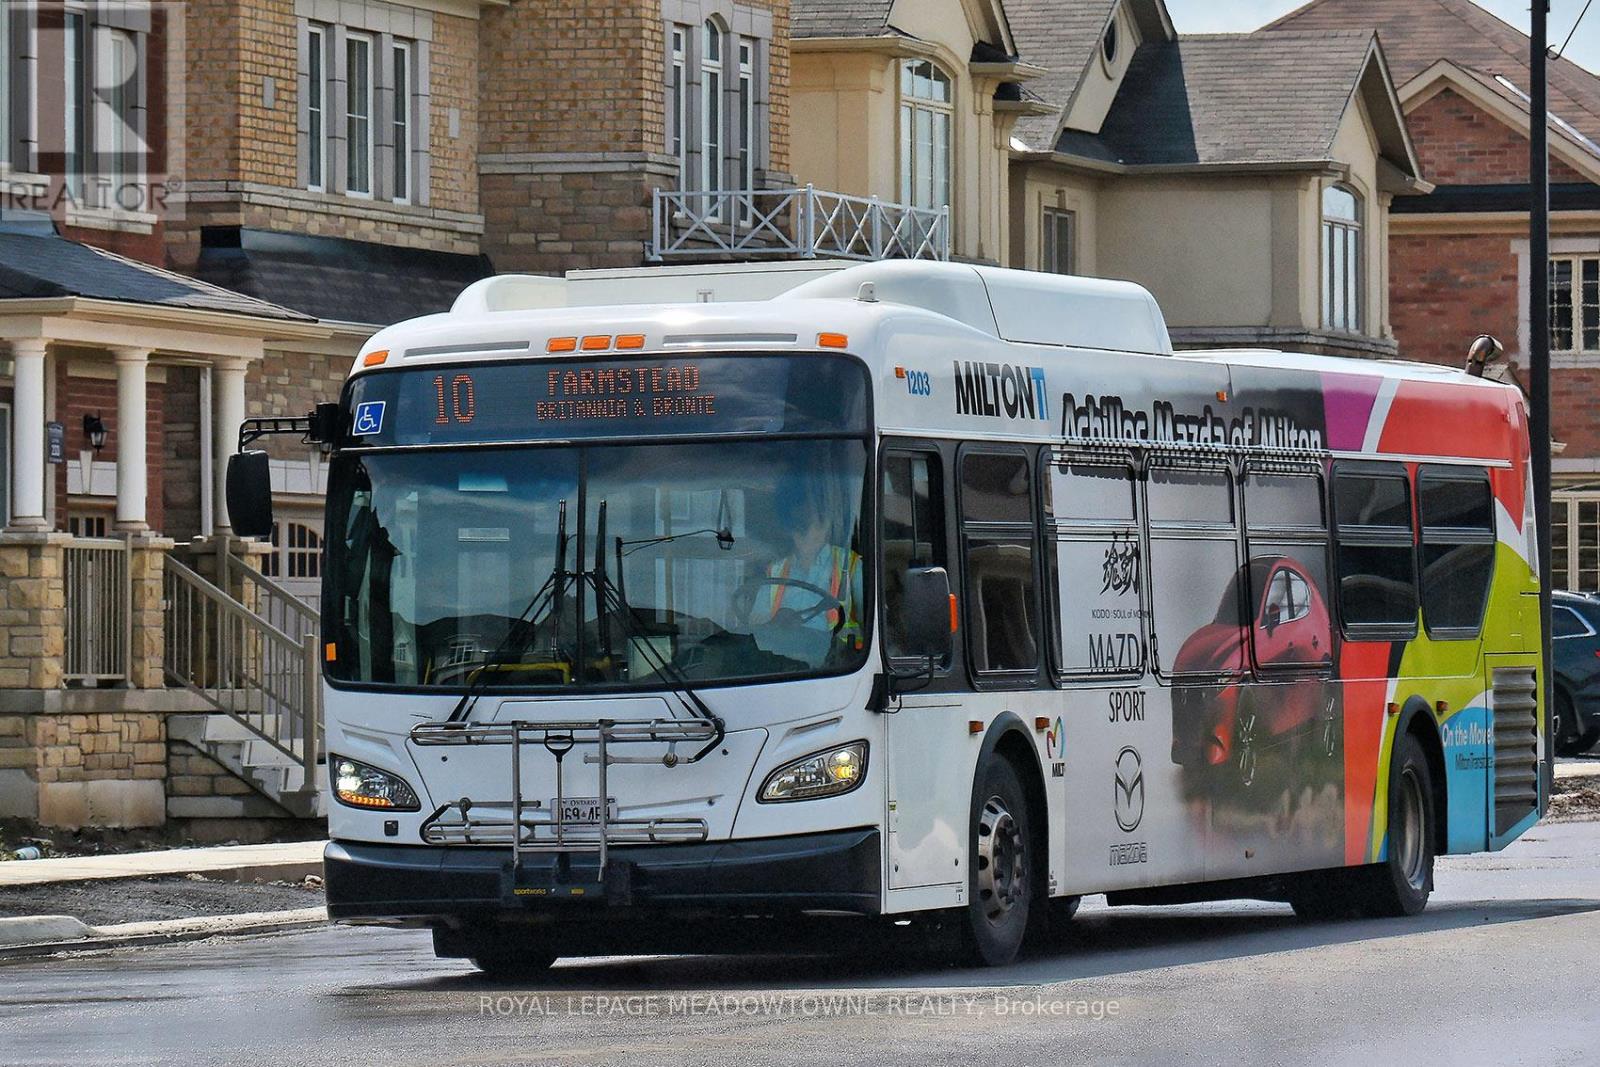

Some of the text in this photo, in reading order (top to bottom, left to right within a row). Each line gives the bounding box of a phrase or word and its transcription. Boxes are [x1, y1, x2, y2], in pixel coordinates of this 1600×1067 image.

[547, 365, 701, 396] FARMSTEAD
[905, 370, 931, 396] 1203
[434, 375, 476, 424] 10
[653, 395, 716, 416] BRONTE
[1109, 691, 1146, 723] SPORT
[1442, 723, 1454, 748] On
[1455, 720, 1468, 746] the
[1109, 842, 1147, 866] mazda
